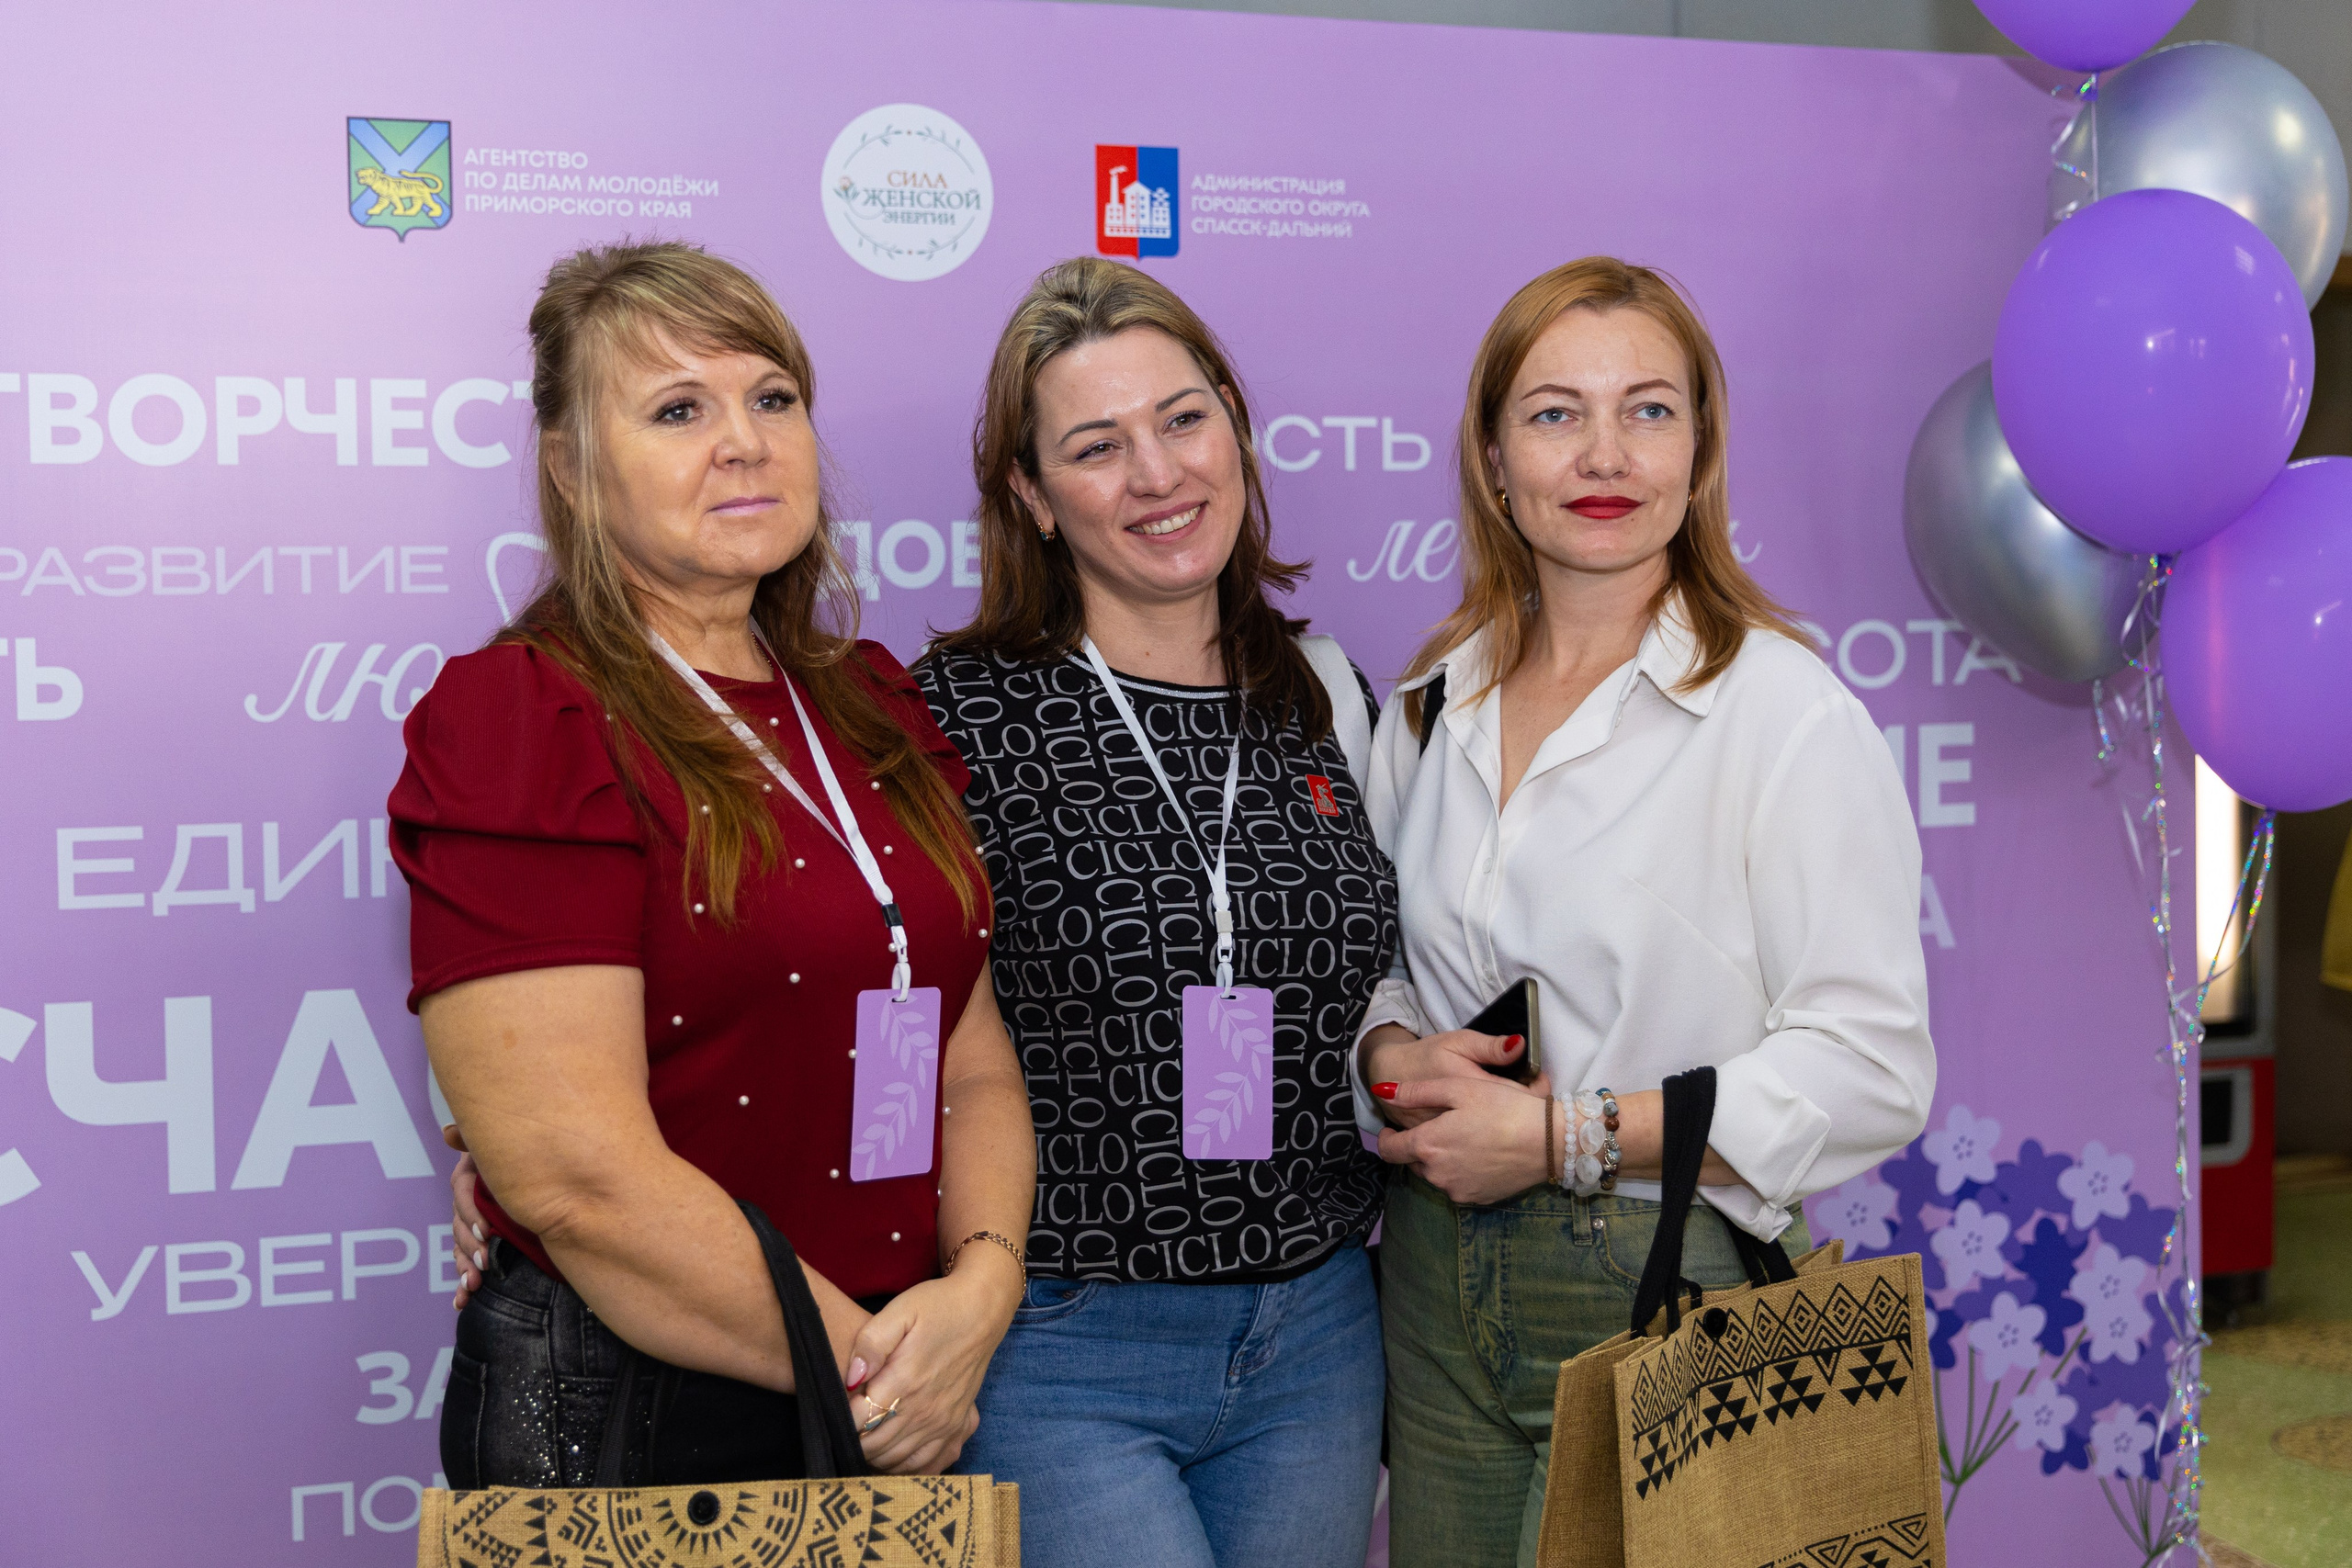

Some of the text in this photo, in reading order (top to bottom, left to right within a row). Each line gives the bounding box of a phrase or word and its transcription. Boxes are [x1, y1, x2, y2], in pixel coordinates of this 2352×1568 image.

[464, 148, 588, 169] АГЕНТСТВО
[464, 170, 719, 198] ПО ДЕЛАМ МОЛОДЁЖИ
[887, 170, 948, 189] СИЛА
[1191, 174, 1346, 196] АДМИНИСТРАЦИЯ
[465, 194, 692, 219] ПРИМОРСКОГО КРАЯ
[862, 187, 981, 210] ЖЕНСКОЙ
[1191, 195, 1372, 218] ГОРОДСКОГО ОКРУГА
[882, 211, 956, 226] ЭНЕРГИИ
[1191, 217, 1354, 239] СПАССК-ДАЛЬНИЙ
[0, 372, 536, 468] ВОРЧЕС
[1035, 697, 1105, 806] CICLO
[998, 794, 1064, 911] CICLO
[1095, 879, 1159, 1008] CICLO
[1055, 1000, 1106, 1128] CICLO
[1131, 1109, 1191, 1235] CICLO
[1127, 1224, 1272, 1281] CICLO
